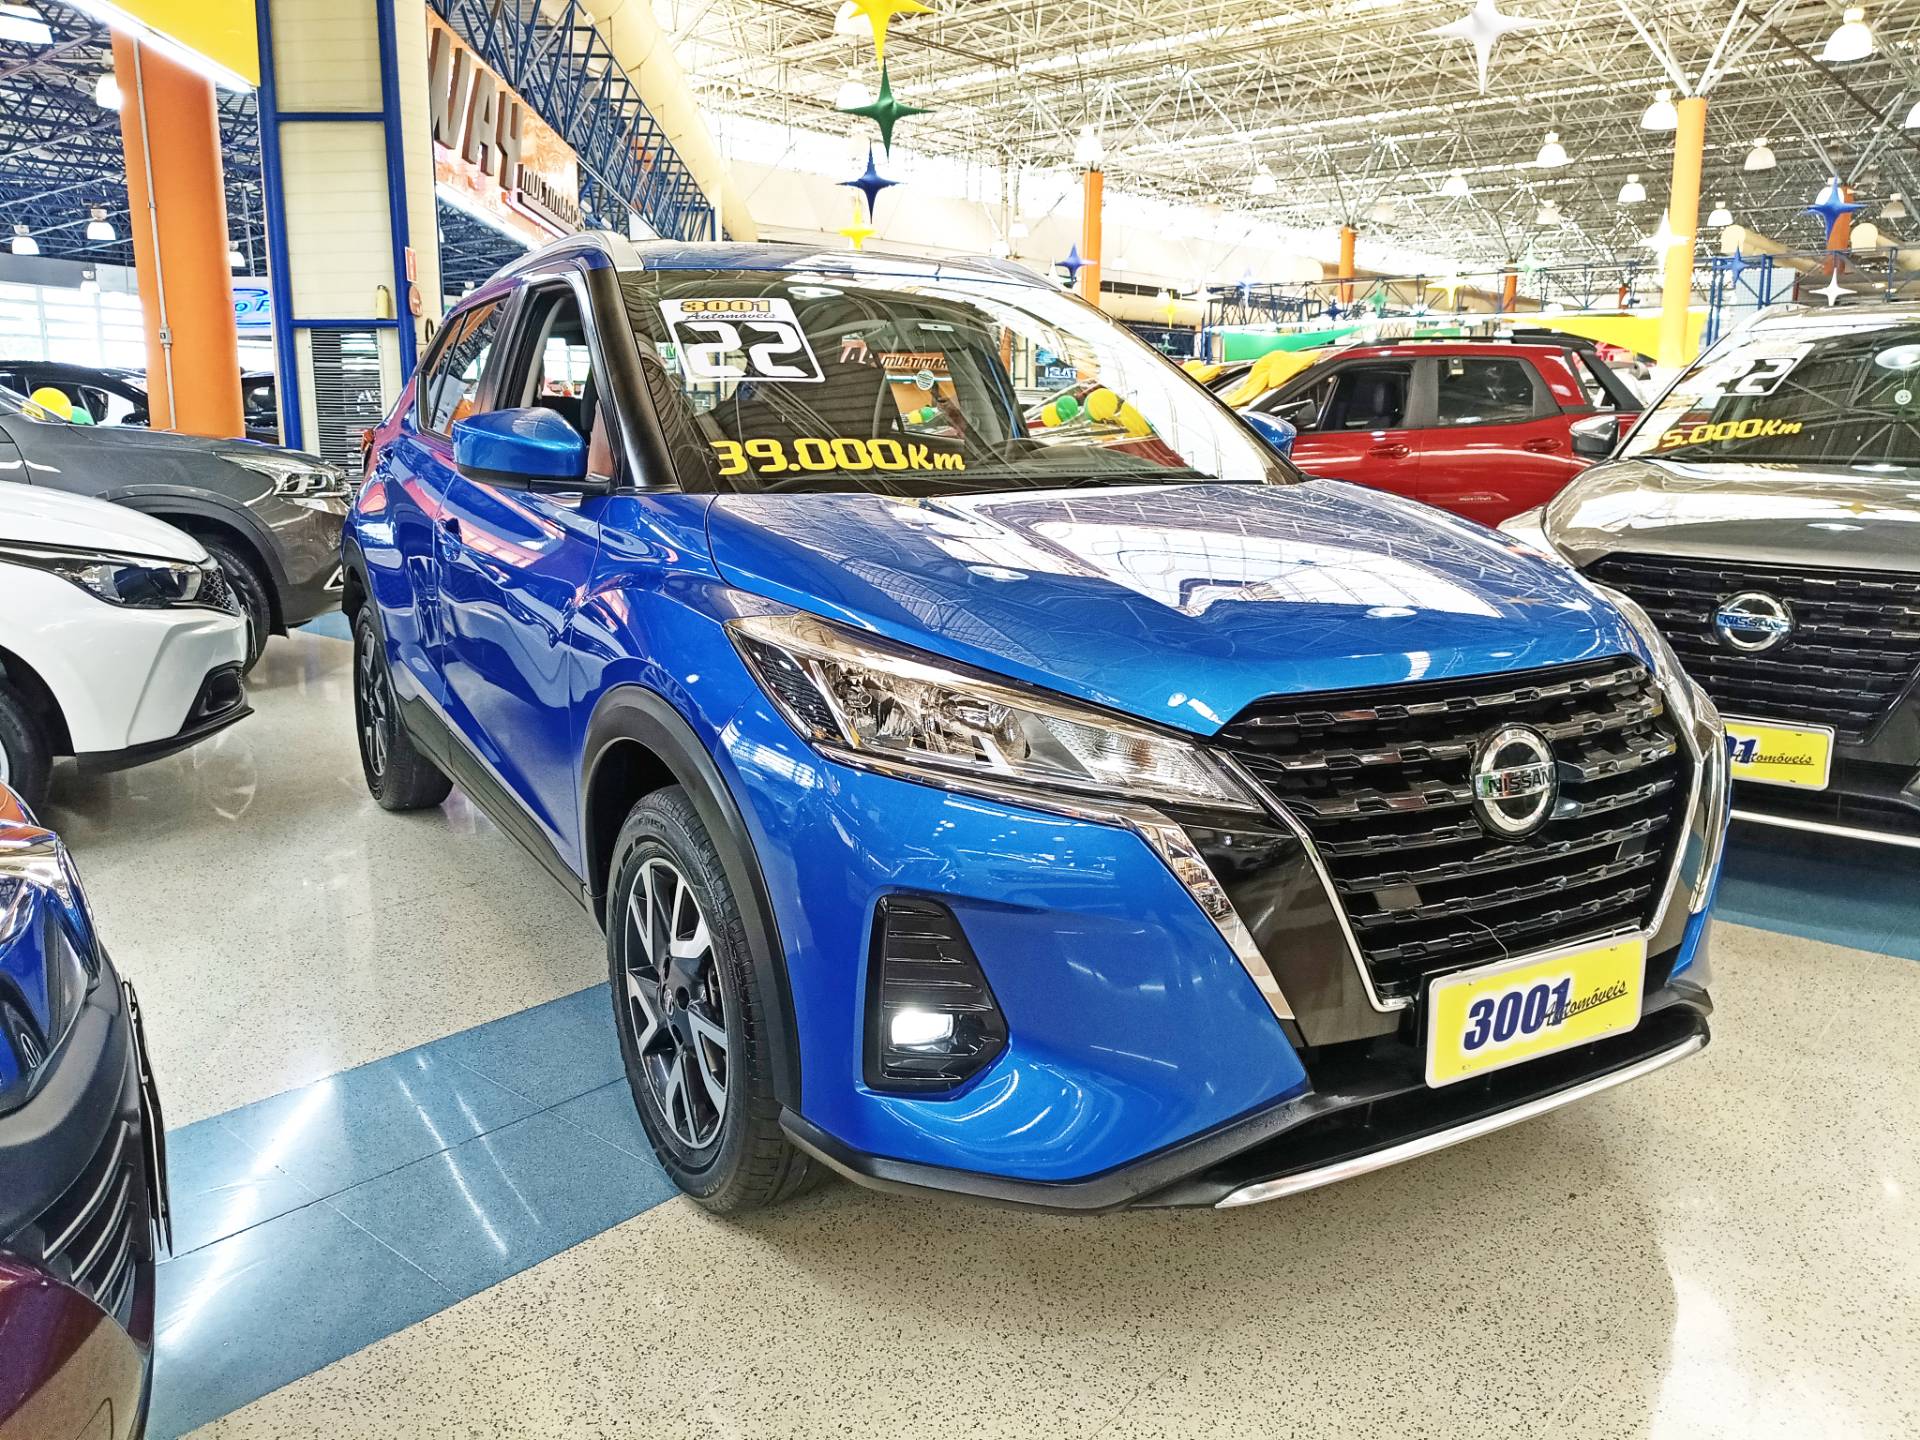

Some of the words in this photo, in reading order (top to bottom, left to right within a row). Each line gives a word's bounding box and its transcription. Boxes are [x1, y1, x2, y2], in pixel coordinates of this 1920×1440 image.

[680, 300, 771, 313] 3001
[682, 321, 809, 378] 22
[1723, 612, 1783, 631] NISSAN
[1488, 770, 1551, 795] NISSAN
[1463, 977, 1571, 1051] 3001
